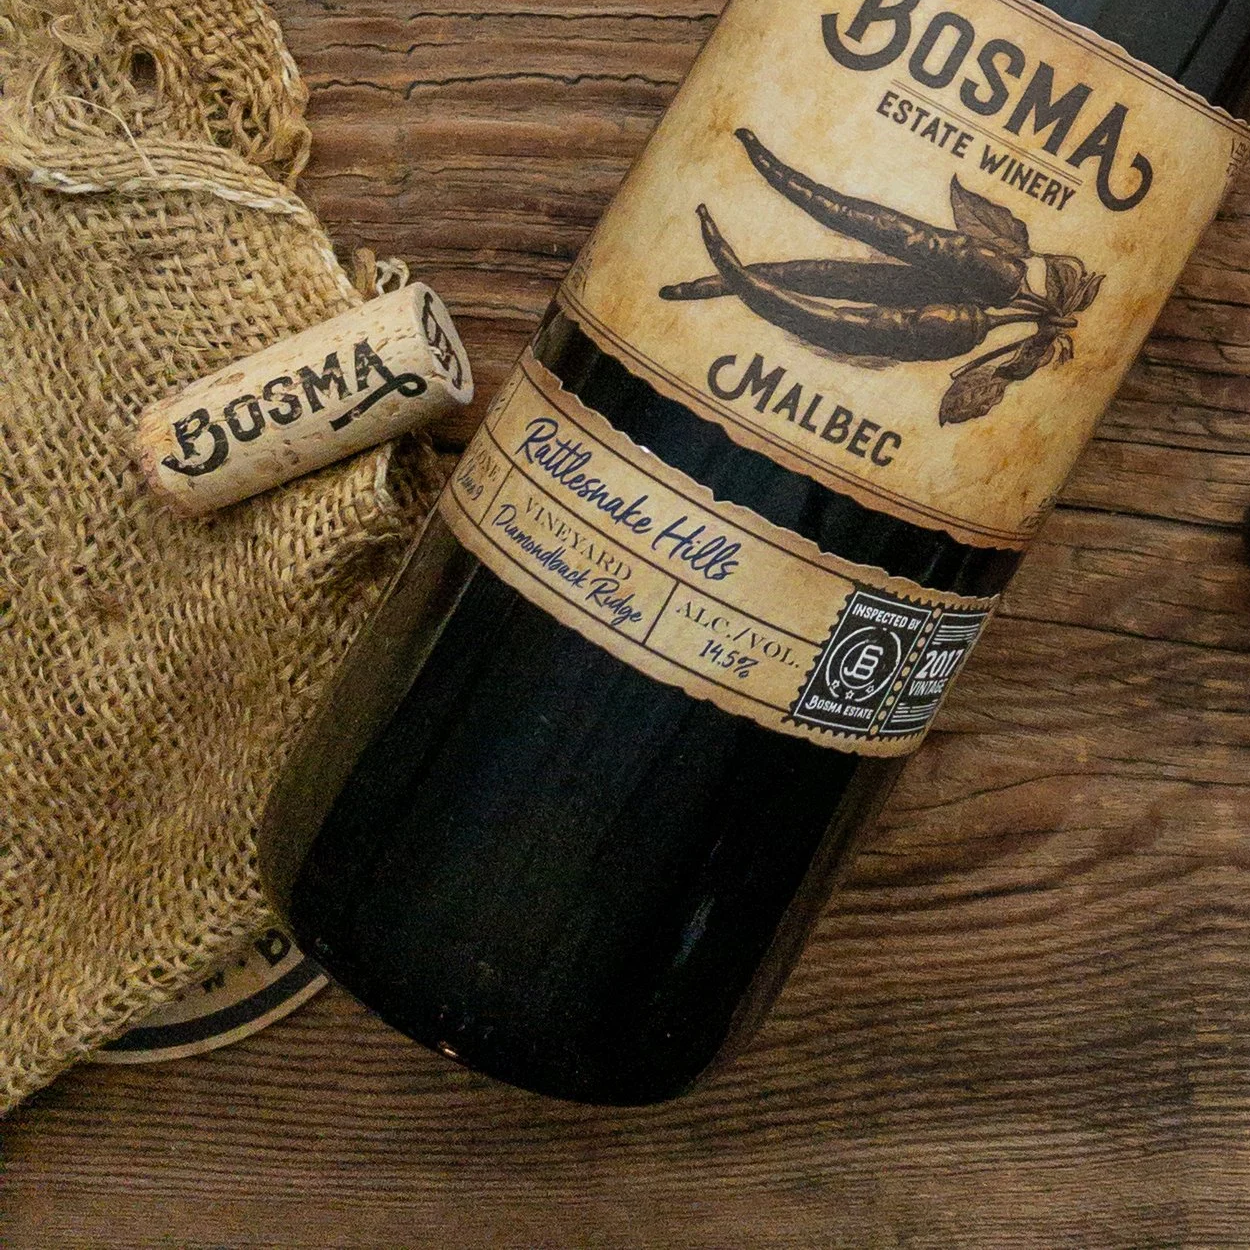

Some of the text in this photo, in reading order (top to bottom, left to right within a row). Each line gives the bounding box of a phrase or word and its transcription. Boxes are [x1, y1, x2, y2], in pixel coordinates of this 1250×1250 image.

[876, 90, 1077, 212] ESTATE WINERY
[160, 336, 428, 477] BOSMA
[707, 353, 902, 467] MALBEC
[515, 417, 653, 534] Rattlesnake
[651, 515, 742, 581] Hills
[524, 497, 633, 582] VINEYARD
[492, 503, 643, 626] Diamondback Ridge
[699, 639, 759, 678] 14.5%
[852, 603, 921, 630] INSPECTED BY
[914, 648, 965, 679] 2017
[805, 695, 874, 720] BOSMA ESTATE
